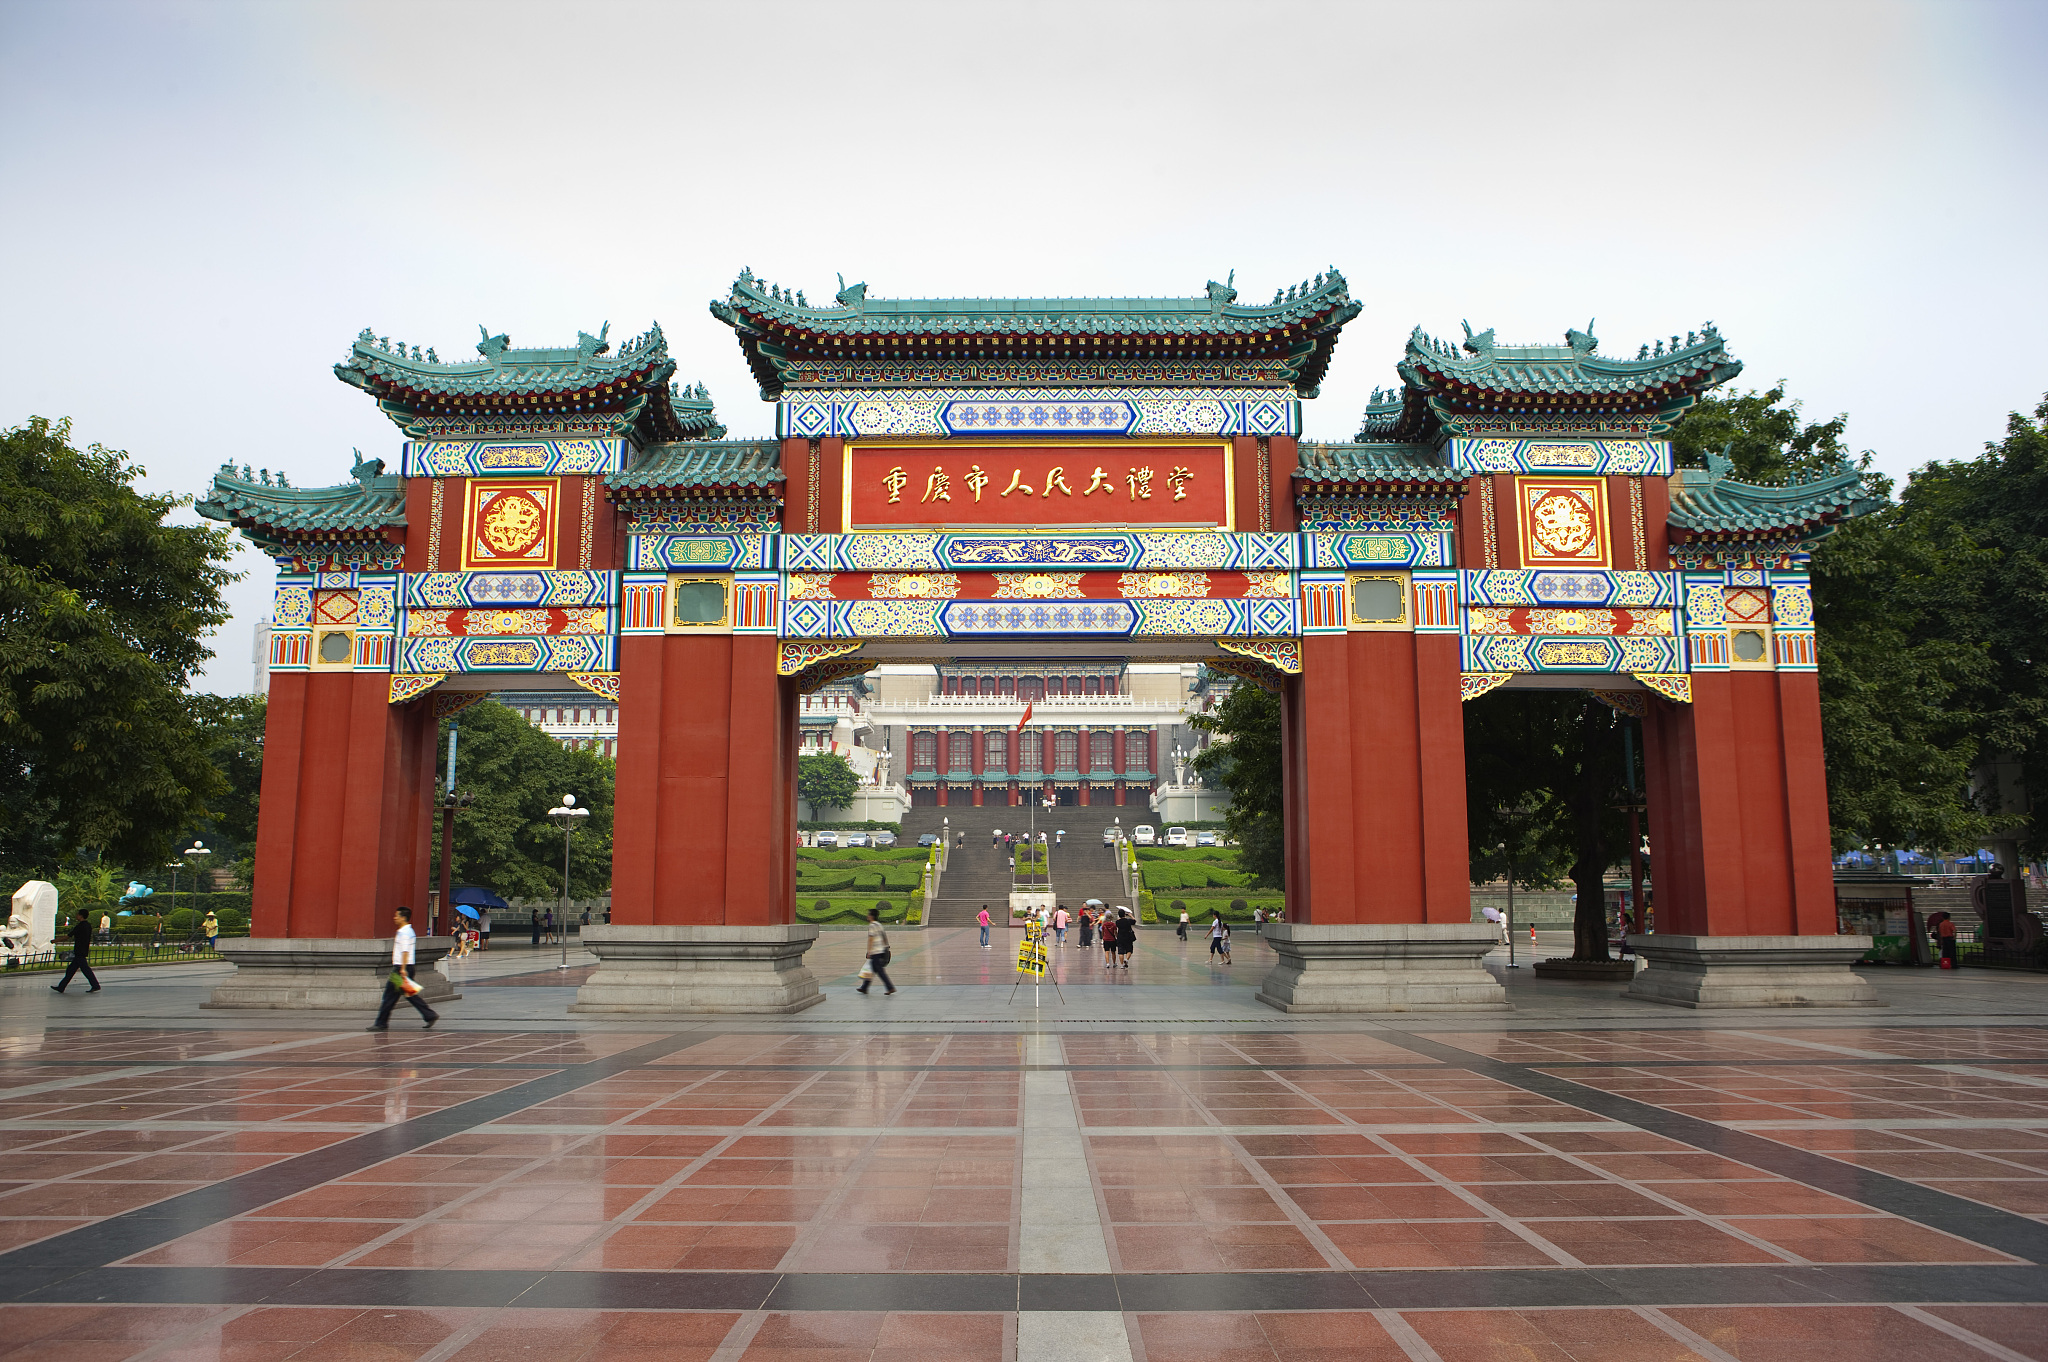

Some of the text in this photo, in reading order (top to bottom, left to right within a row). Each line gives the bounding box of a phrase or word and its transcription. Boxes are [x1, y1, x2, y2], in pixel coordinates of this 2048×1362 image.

[882, 464, 1194, 504] 重慶市人民大禮堂
